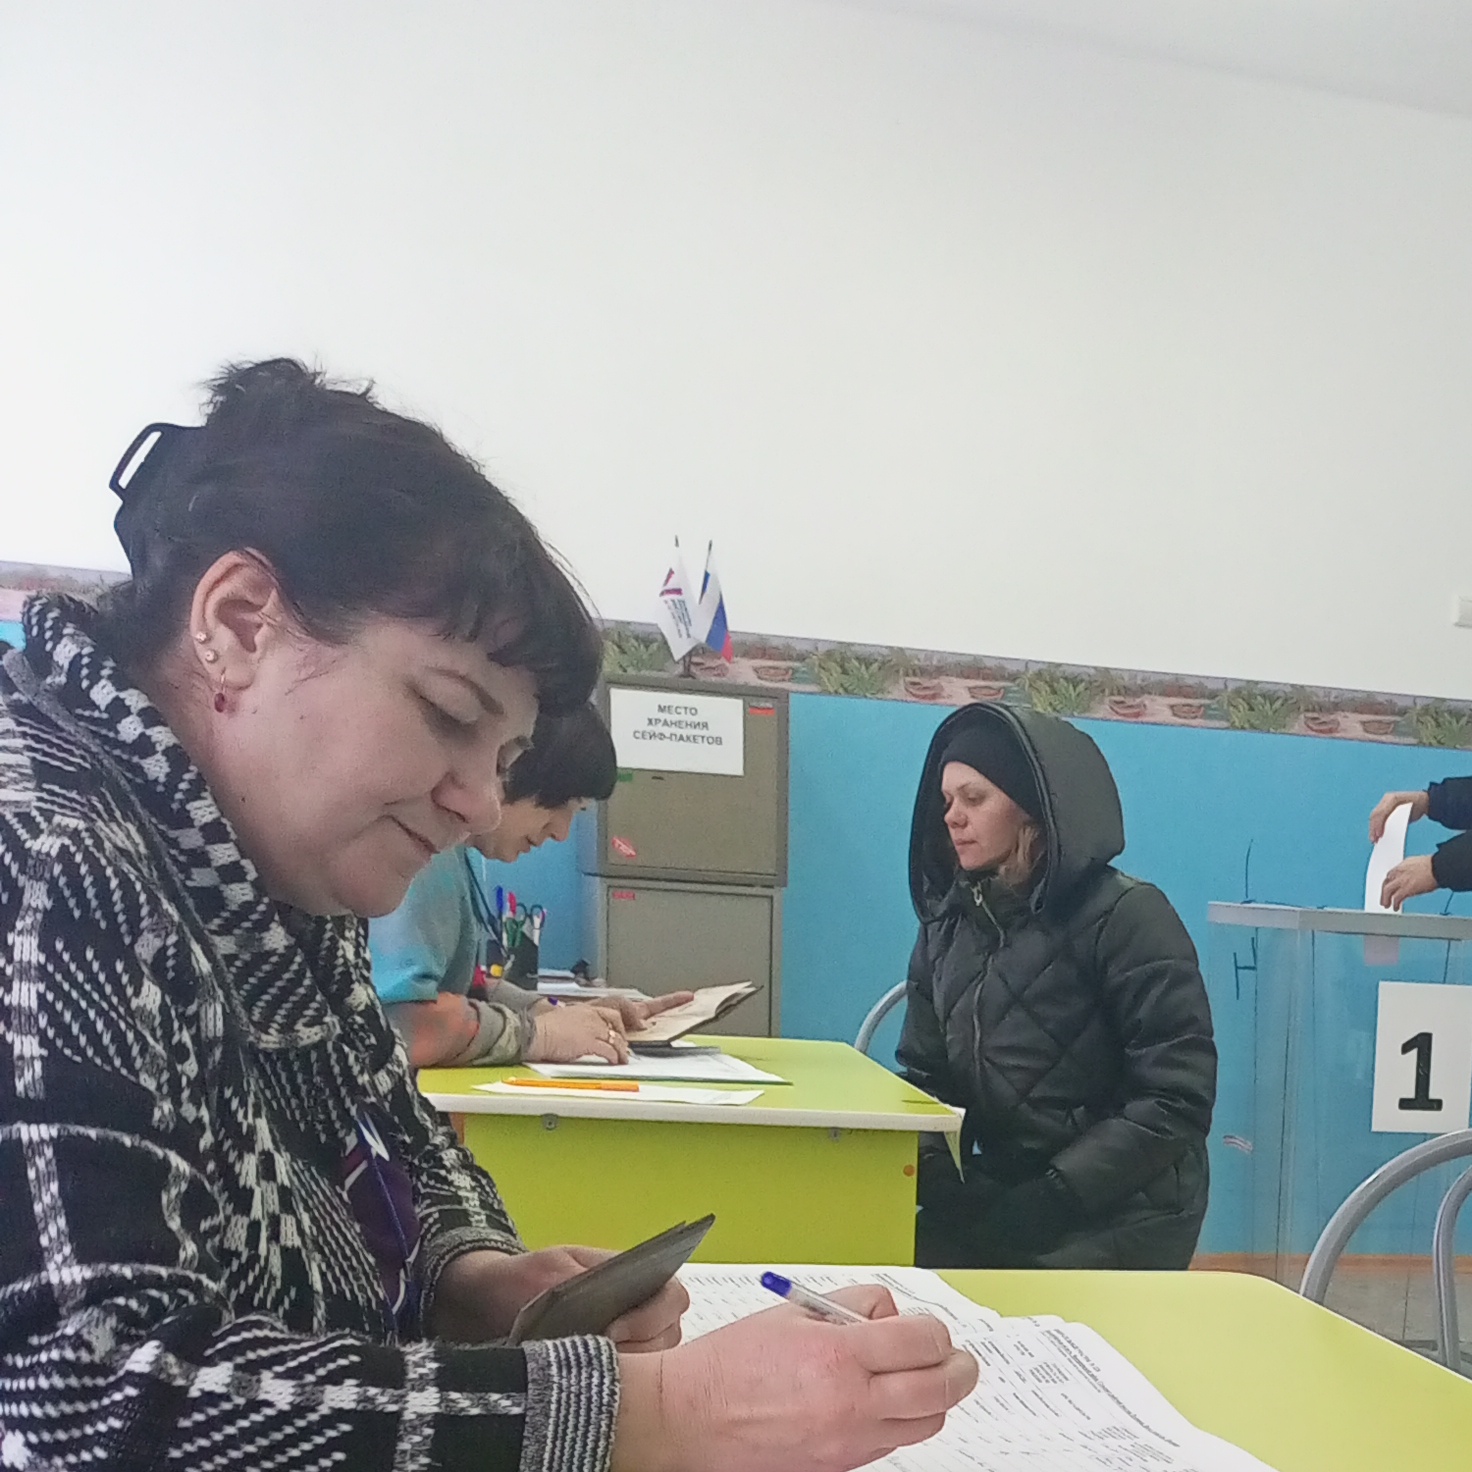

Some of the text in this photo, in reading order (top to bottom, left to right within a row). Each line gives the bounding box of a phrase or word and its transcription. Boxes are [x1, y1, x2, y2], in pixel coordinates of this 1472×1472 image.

[657, 704, 698, 716] МЕСТО
[647, 718, 709, 730] ХРАНЕНИЯ
[632, 730, 723, 745] СЕЙФ-ПАКЕТОВ
[1398, 1032, 1443, 1111] 1
